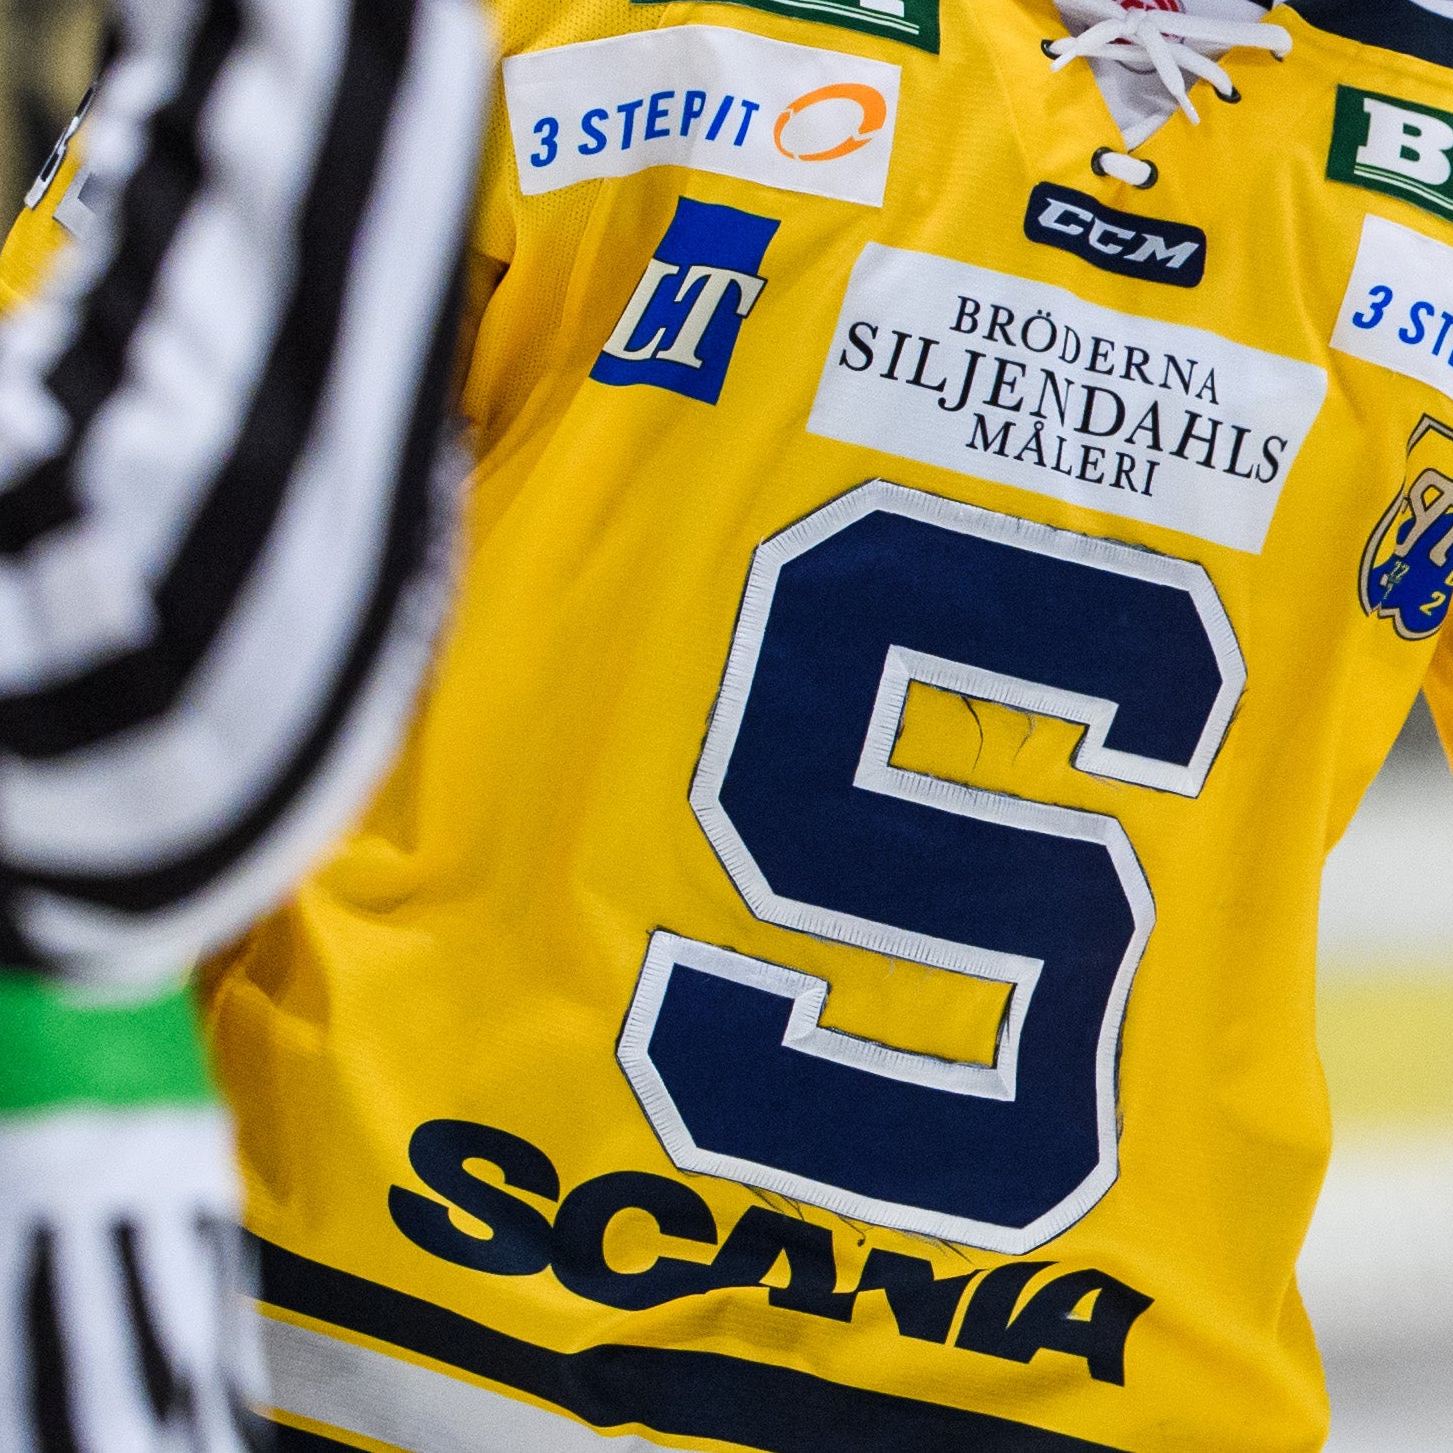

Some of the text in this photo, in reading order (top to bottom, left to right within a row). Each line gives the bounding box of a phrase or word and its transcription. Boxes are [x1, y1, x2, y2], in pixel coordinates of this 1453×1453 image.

[530, 117, 559, 168] 3
[1037, 197, 1200, 269] CCM
[949, 295, 1221, 405] BRÖDERNA
[1352, 285, 1393, 329] 3
[838, 321, 1288, 484] SILJENDAHLS
[965, 413, 1160, 497] MÅLERI
[617, 477, 1248, 1256] S
[387, 1119, 1155, 1387] SCANIA
